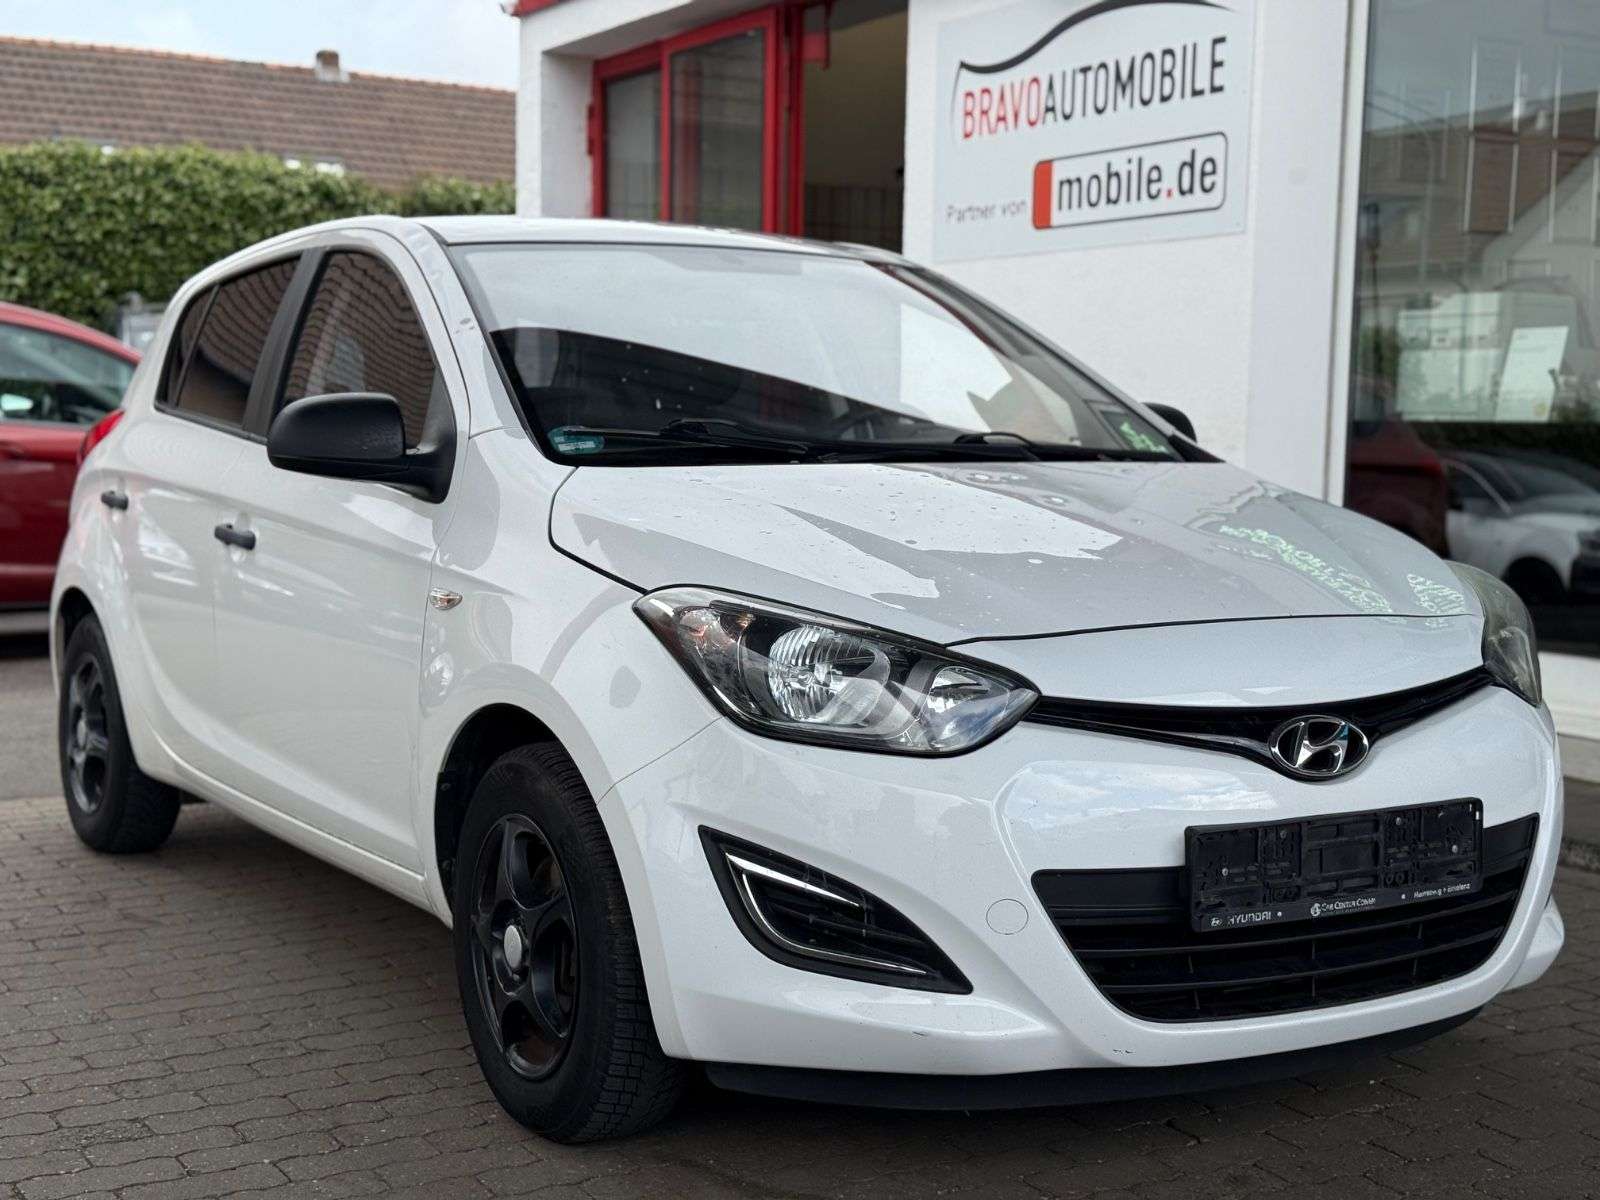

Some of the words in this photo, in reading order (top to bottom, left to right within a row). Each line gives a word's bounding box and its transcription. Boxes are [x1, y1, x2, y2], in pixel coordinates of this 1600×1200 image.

[962, 36, 1227, 140] BRAVOAUTOMOBILE
[945, 204, 995, 223] Partner
[1002, 199, 1026, 217] von
[1057, 148, 1218, 212] mobile.de
